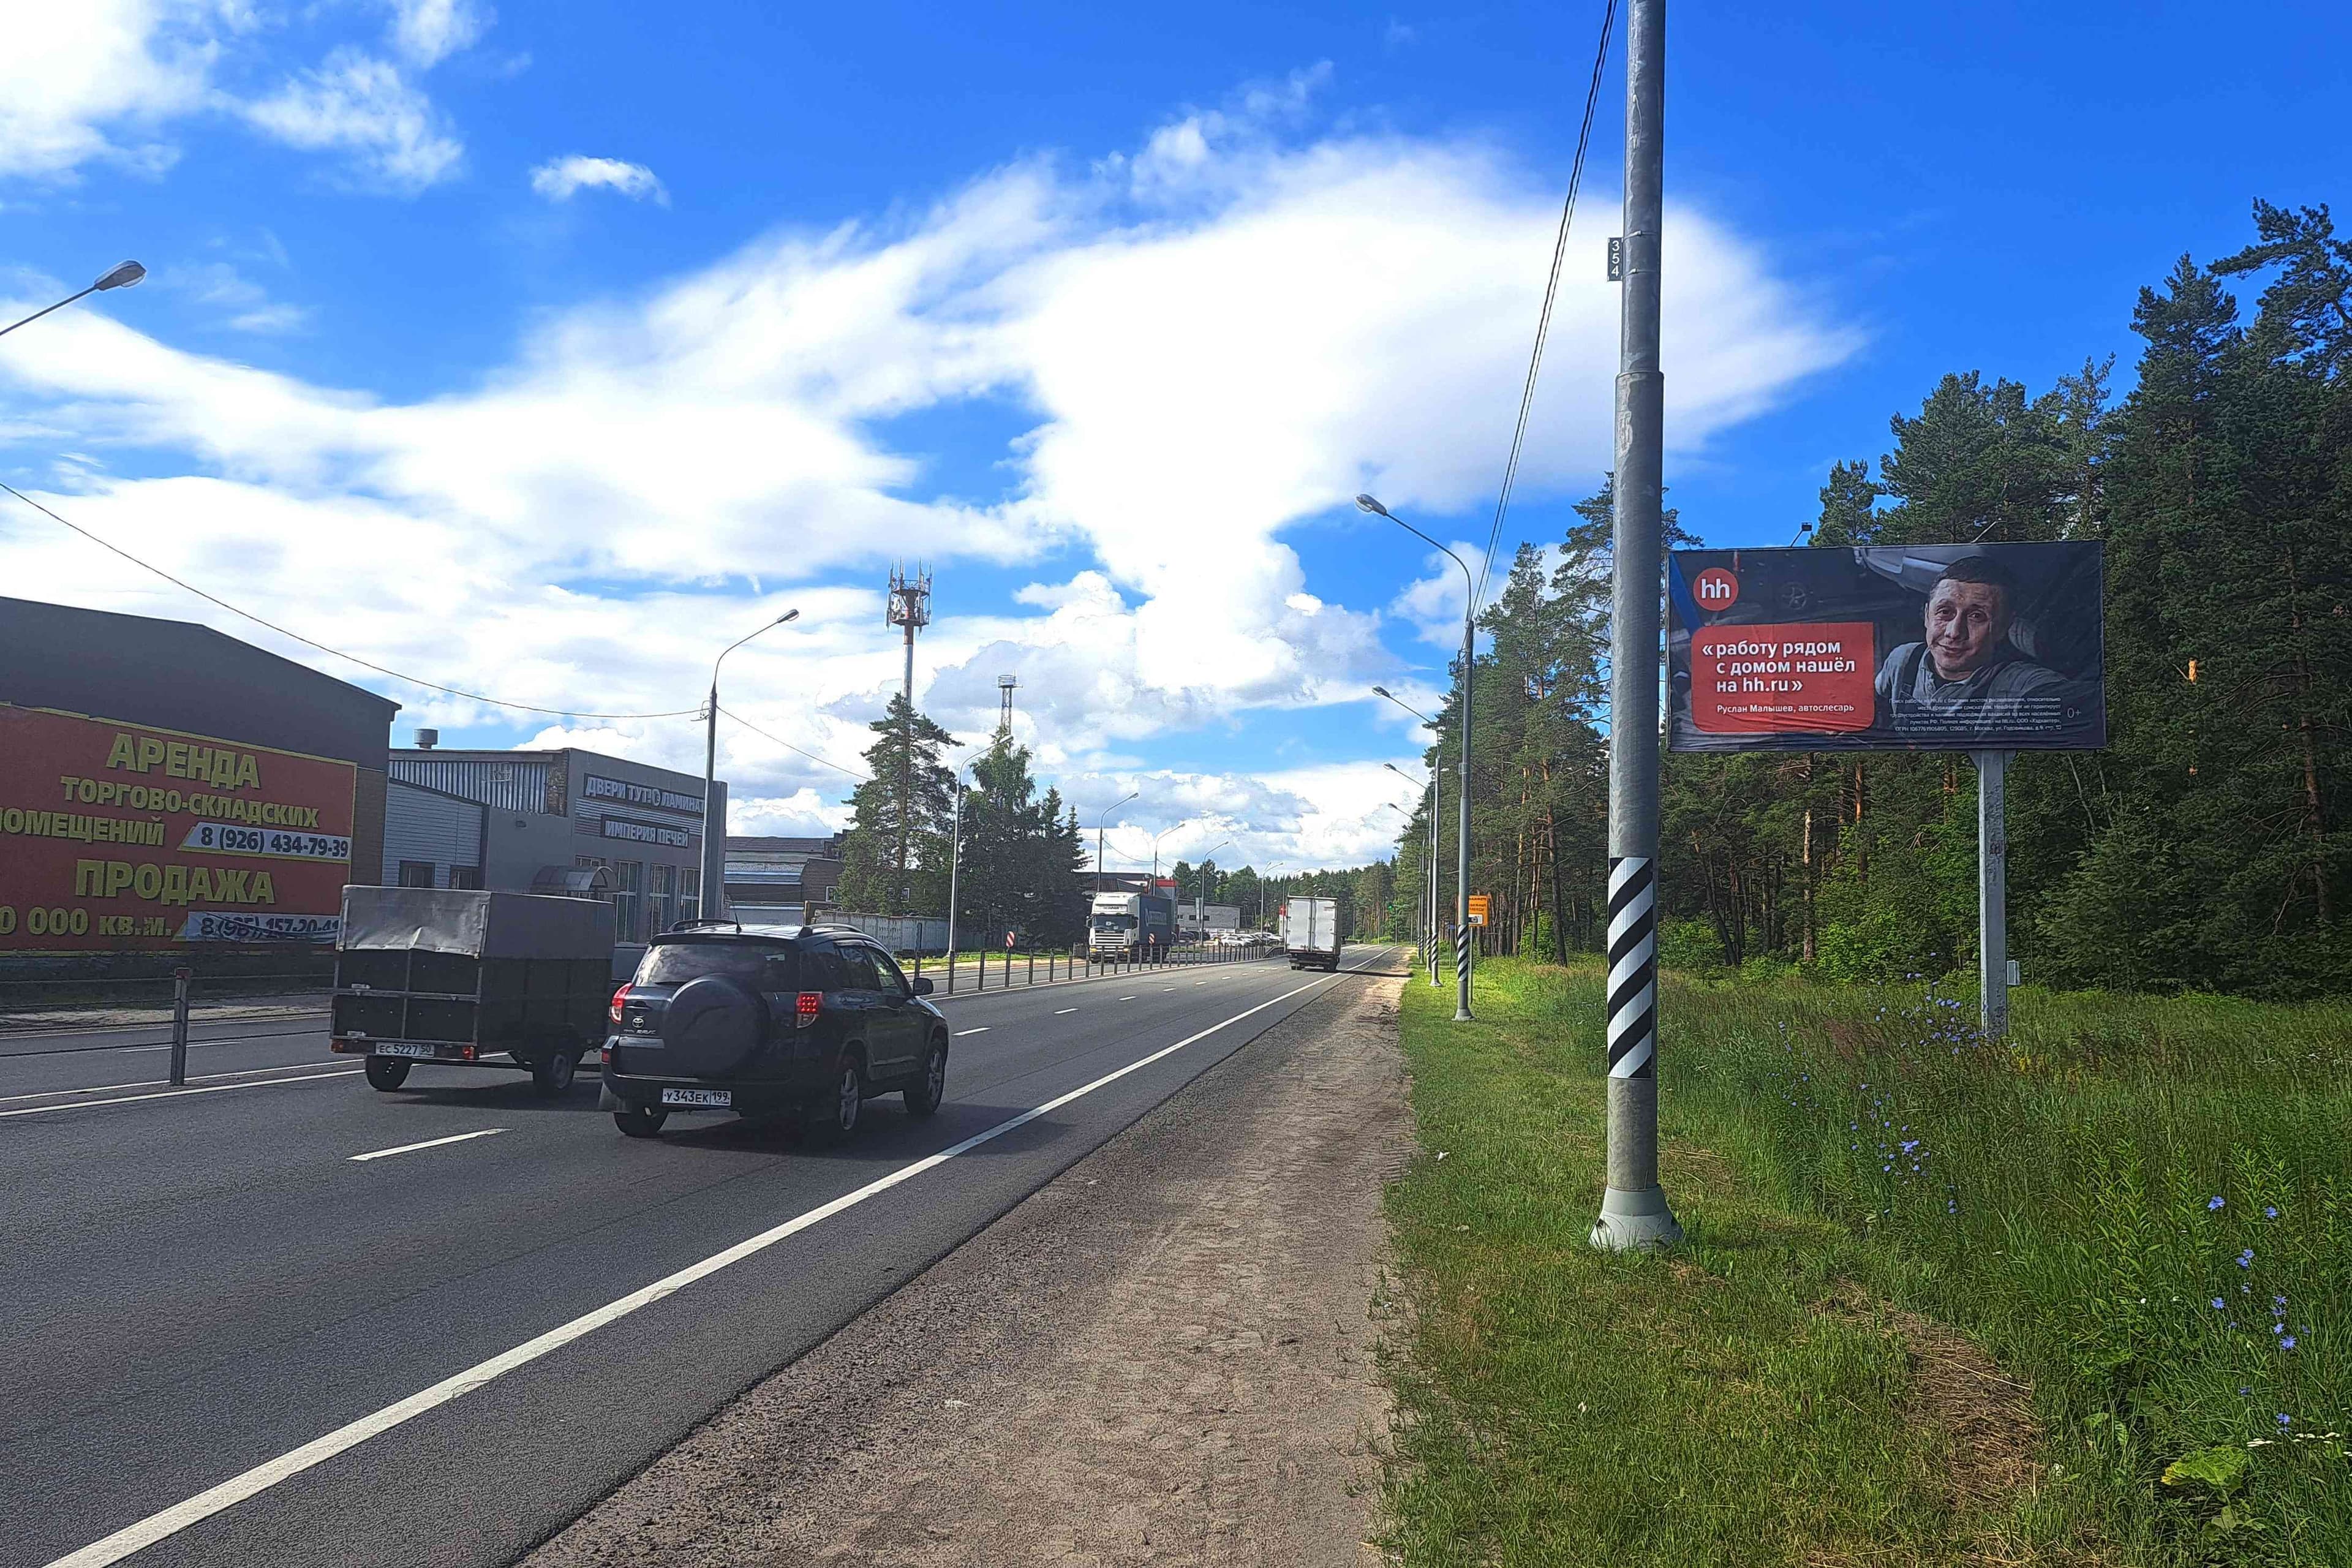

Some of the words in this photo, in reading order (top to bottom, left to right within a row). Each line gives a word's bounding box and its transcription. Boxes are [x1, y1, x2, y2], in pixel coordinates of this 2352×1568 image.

[1611, 240, 1620, 277] 354
[1702, 578, 1730, 598] hh
[1783, 642, 1841, 657] рядом
[1716, 662, 1725, 673] с
[1730, 661, 1790, 676] домом
[1796, 657, 1855, 673] нашёл
[1717, 680, 1737, 692] на
[1717, 705, 1747, 714] Руслан
[1750, 704, 1796, 713] Малышев,
[1798, 704, 1855, 712] автослесарь
[2067, 707, 2082, 718] 0+
[105, 732, 260, 791] АРЕНДА
[586, 776, 626, 799] ДВЕРИ
[61, 775, 320, 828] ТОРГОВО-СКЛАДСКИХ
[201, 827, 213, 846] 8
[219, 827, 265, 854] (926)
[271, 834, 349, 858] 434-79-39
[605, 820, 656, 842] ИМПЕРИЯ
[657, 827, 688, 848] ПЕЧЕЙ
[75, 859, 275, 905] ПРОДАЖА
[28, 907, 89, 935] 000
[712, 1091, 728, 1101] 199
